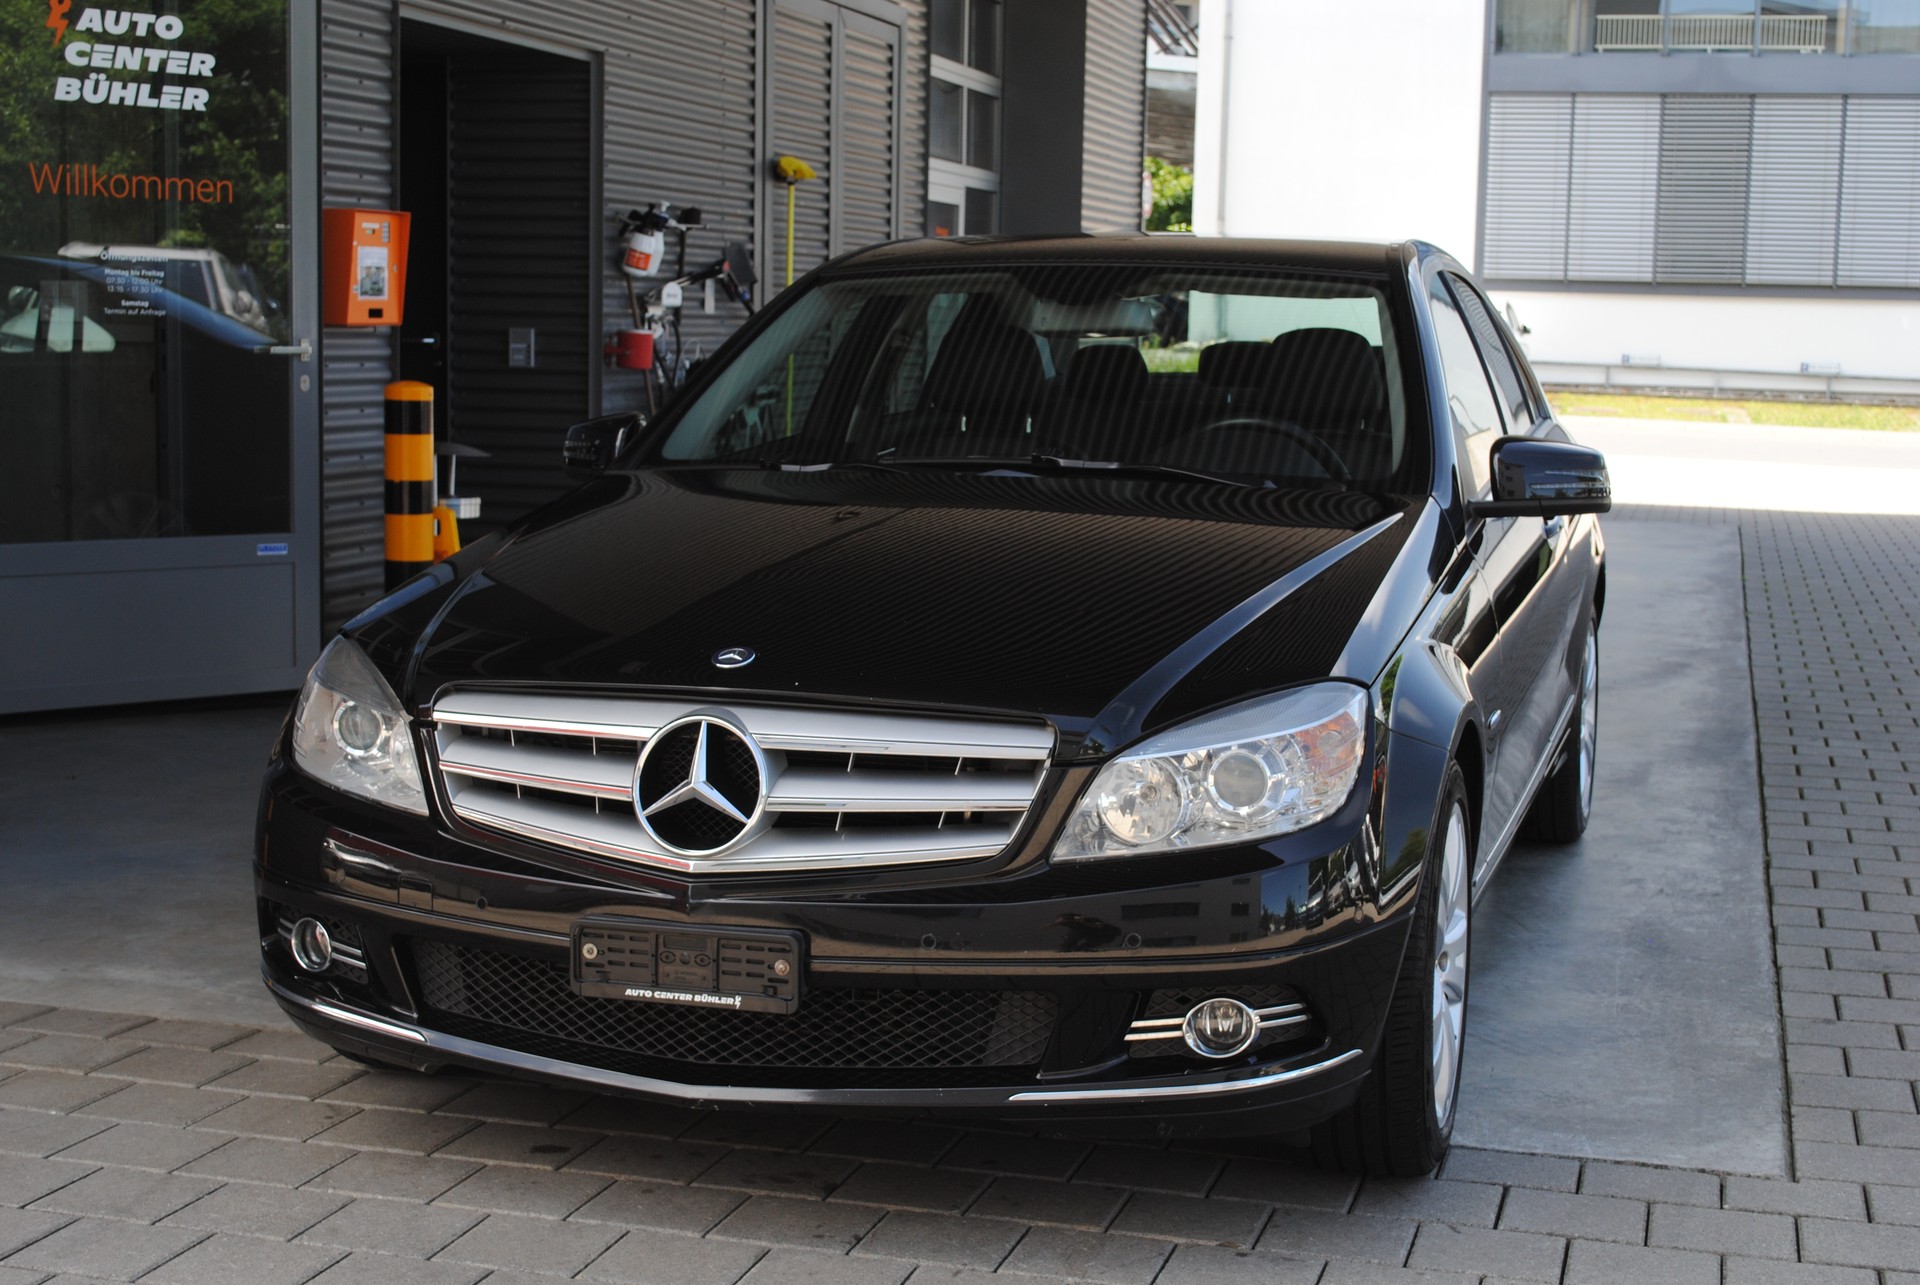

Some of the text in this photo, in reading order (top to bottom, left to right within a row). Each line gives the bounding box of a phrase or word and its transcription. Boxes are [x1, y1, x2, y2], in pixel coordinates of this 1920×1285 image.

[75, 7, 184, 40] AUTO
[64, 41, 216, 77] CENTER
[54, 72, 210, 112] BÜHLER
[29, 161, 233, 204] Willkommen
[104, 268, 129, 277] Montag
[141, 269, 165, 278] Freitag
[104, 307, 126, 315] Termin
[140, 309, 166, 317] Anfrage
[121, 300, 149, 308] Samstag
[625, 988, 734, 1005] AUTO CENTER BÜHLER
